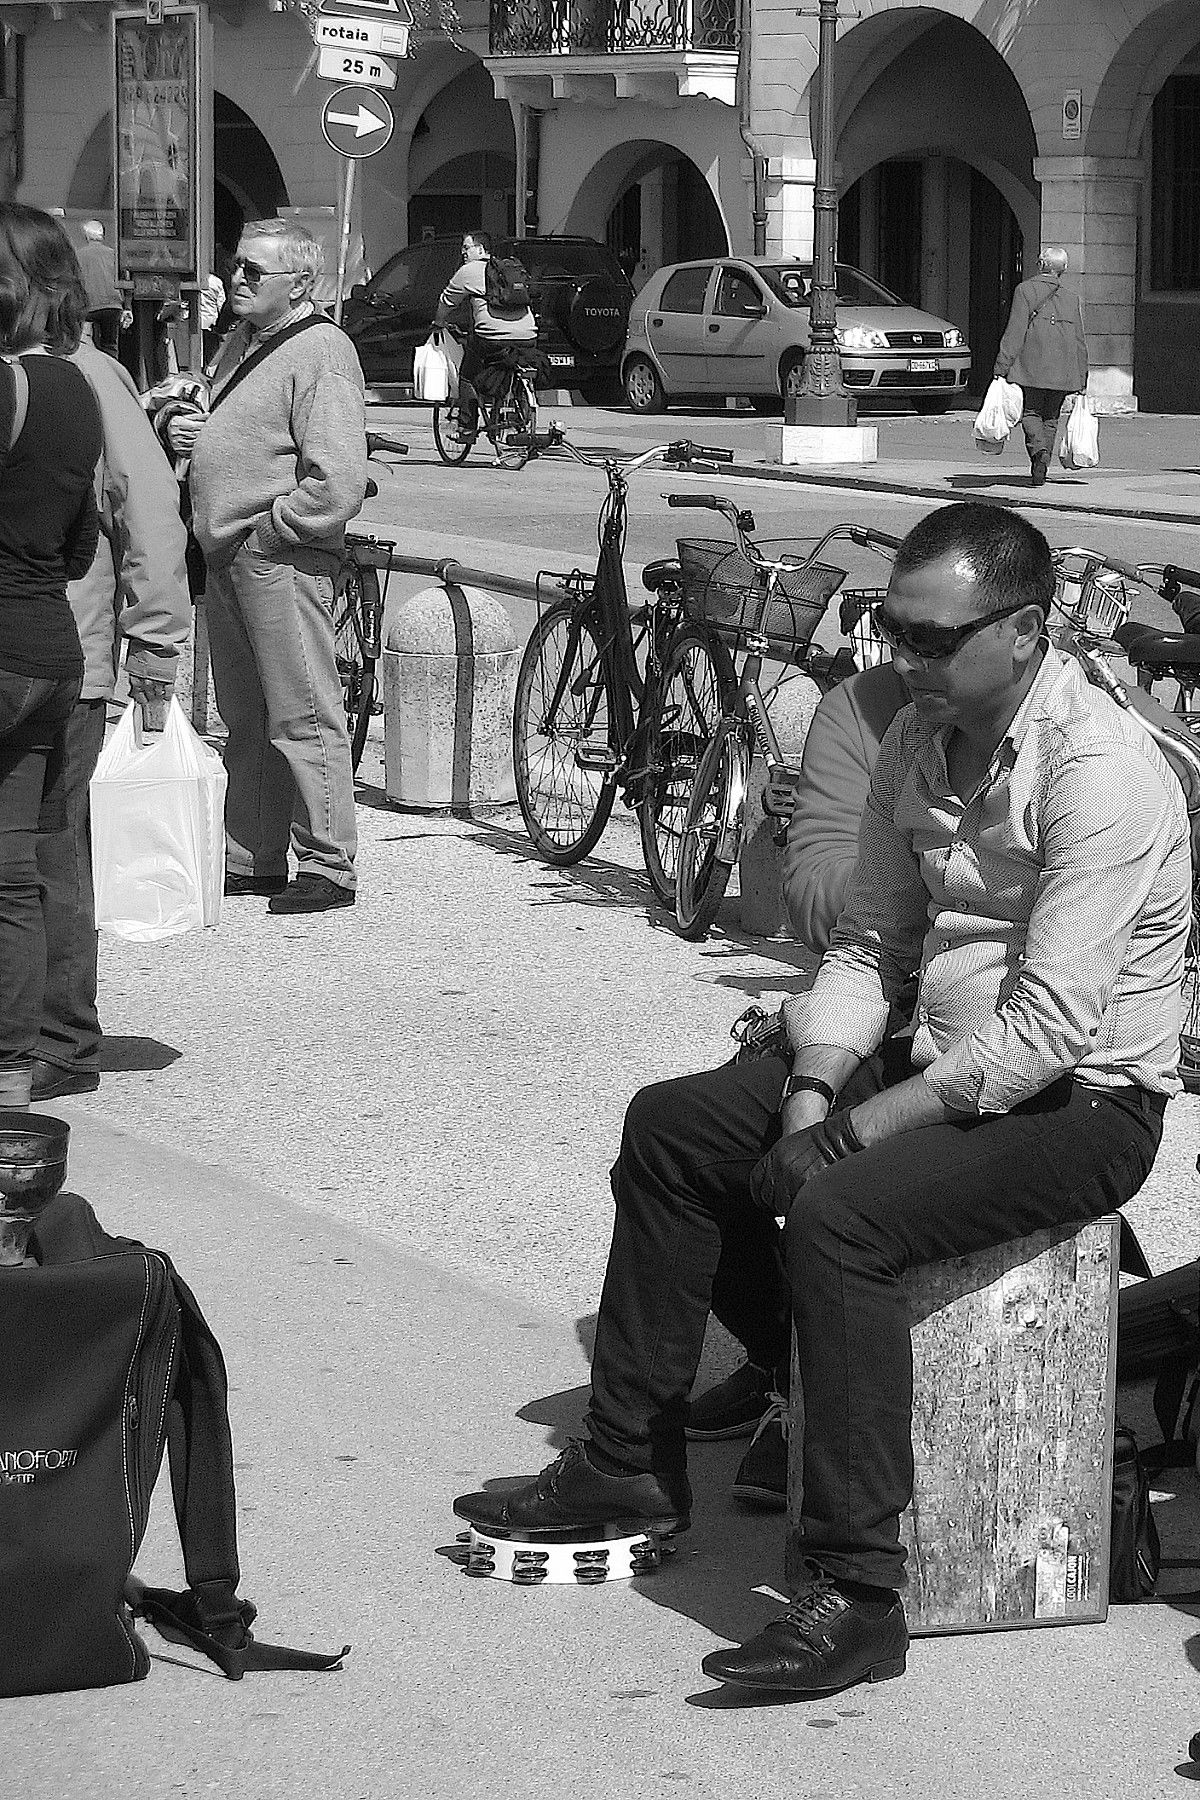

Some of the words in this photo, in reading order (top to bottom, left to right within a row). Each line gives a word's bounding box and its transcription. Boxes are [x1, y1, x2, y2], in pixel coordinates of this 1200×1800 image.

[322, 26, 369, 41] rotaia
[342, 58, 364, 74] 25
[369, 65, 381, 77] m
[584, 307, 620, 317] TOYOTA
